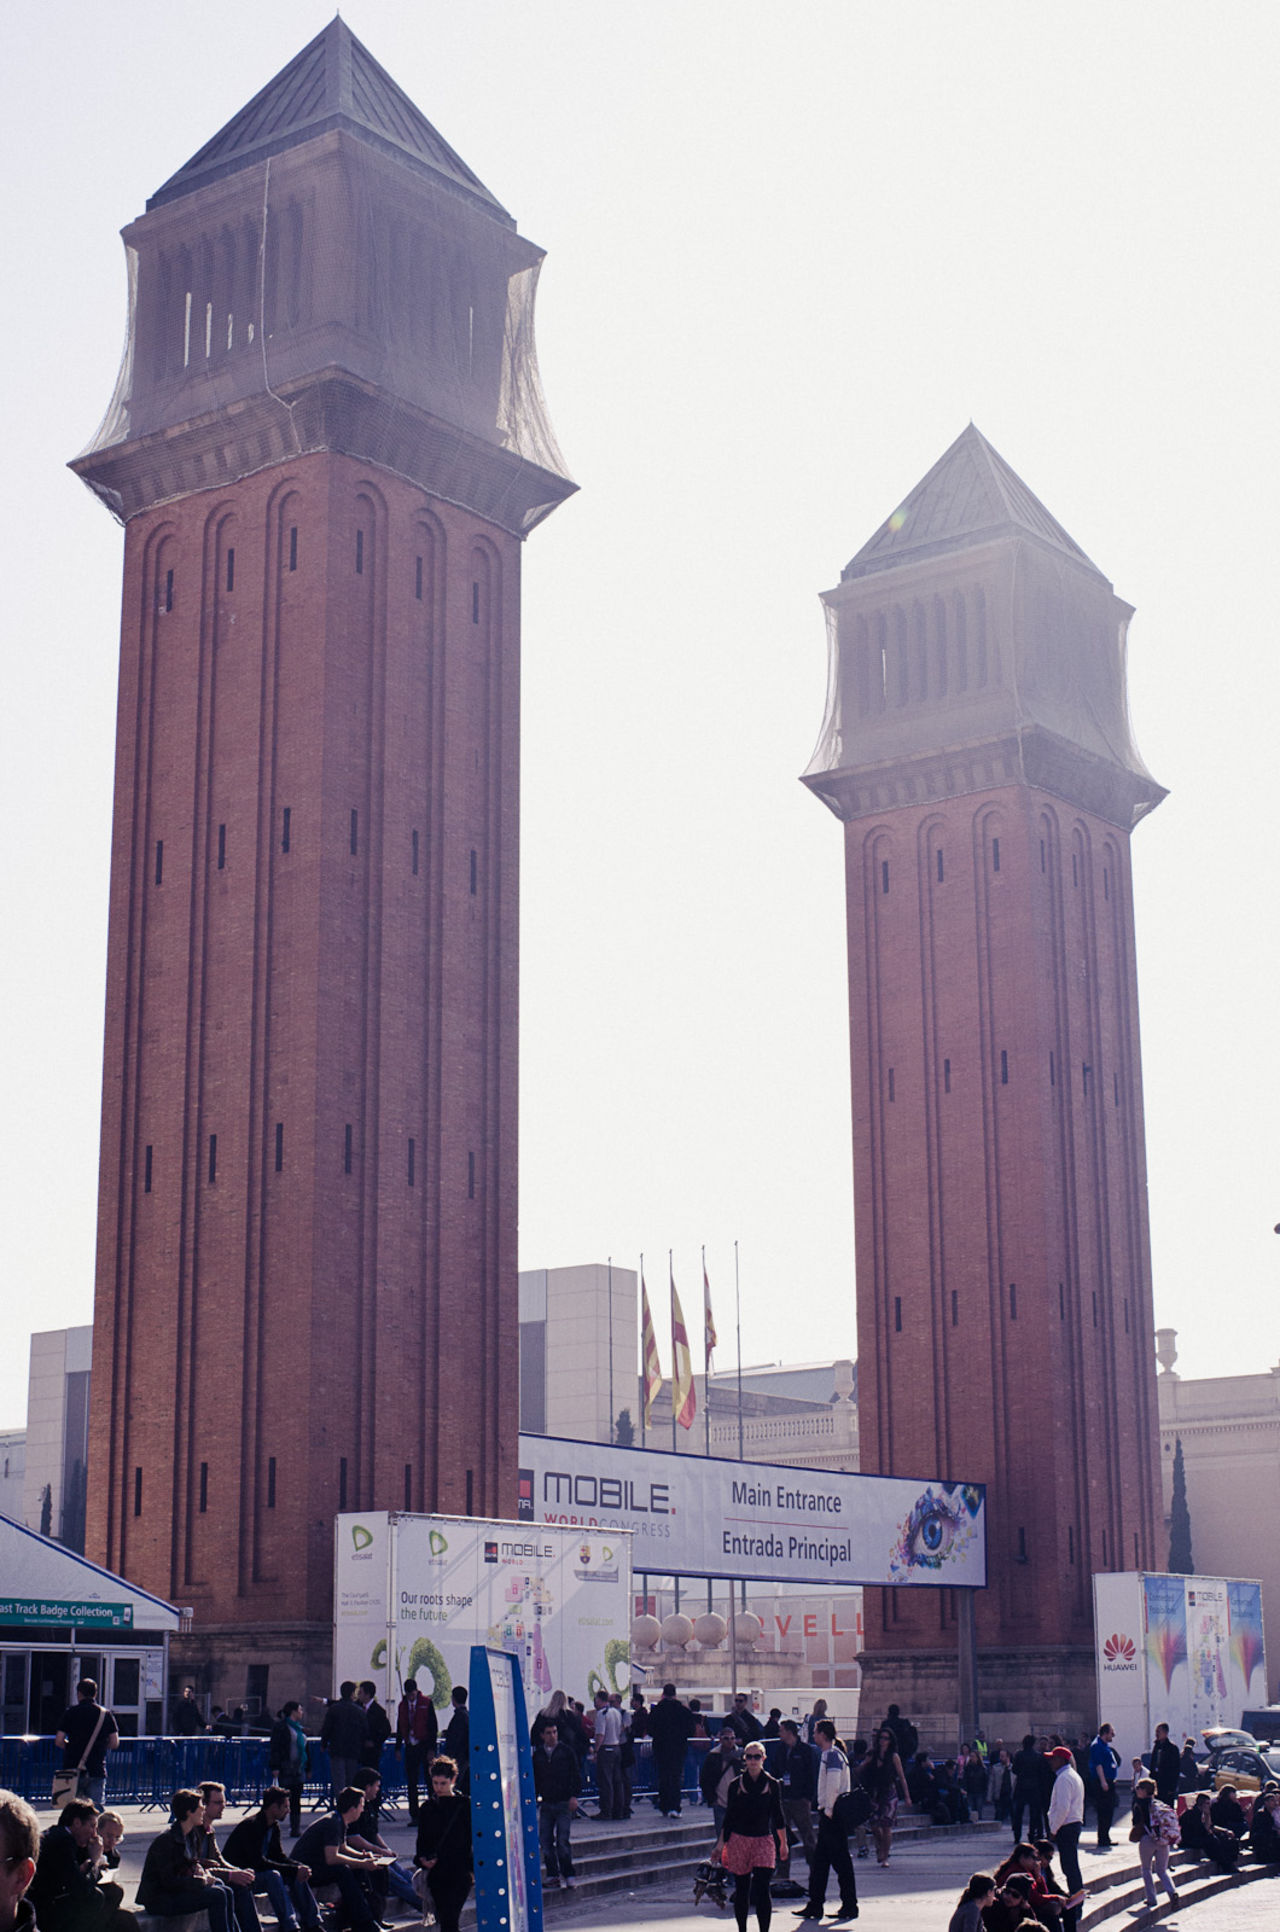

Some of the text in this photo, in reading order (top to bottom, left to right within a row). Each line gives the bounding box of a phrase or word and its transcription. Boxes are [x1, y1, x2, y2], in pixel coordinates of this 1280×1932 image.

[732, 1481, 842, 1513] Main Entrance
[722, 1531, 852, 1567] Entrada Principal
[401, 1591, 473, 1608] Our roots shape
[0, 1603, 113, 1618] ast Track Badge Collection
[401, 1607, 448, 1621] the future
